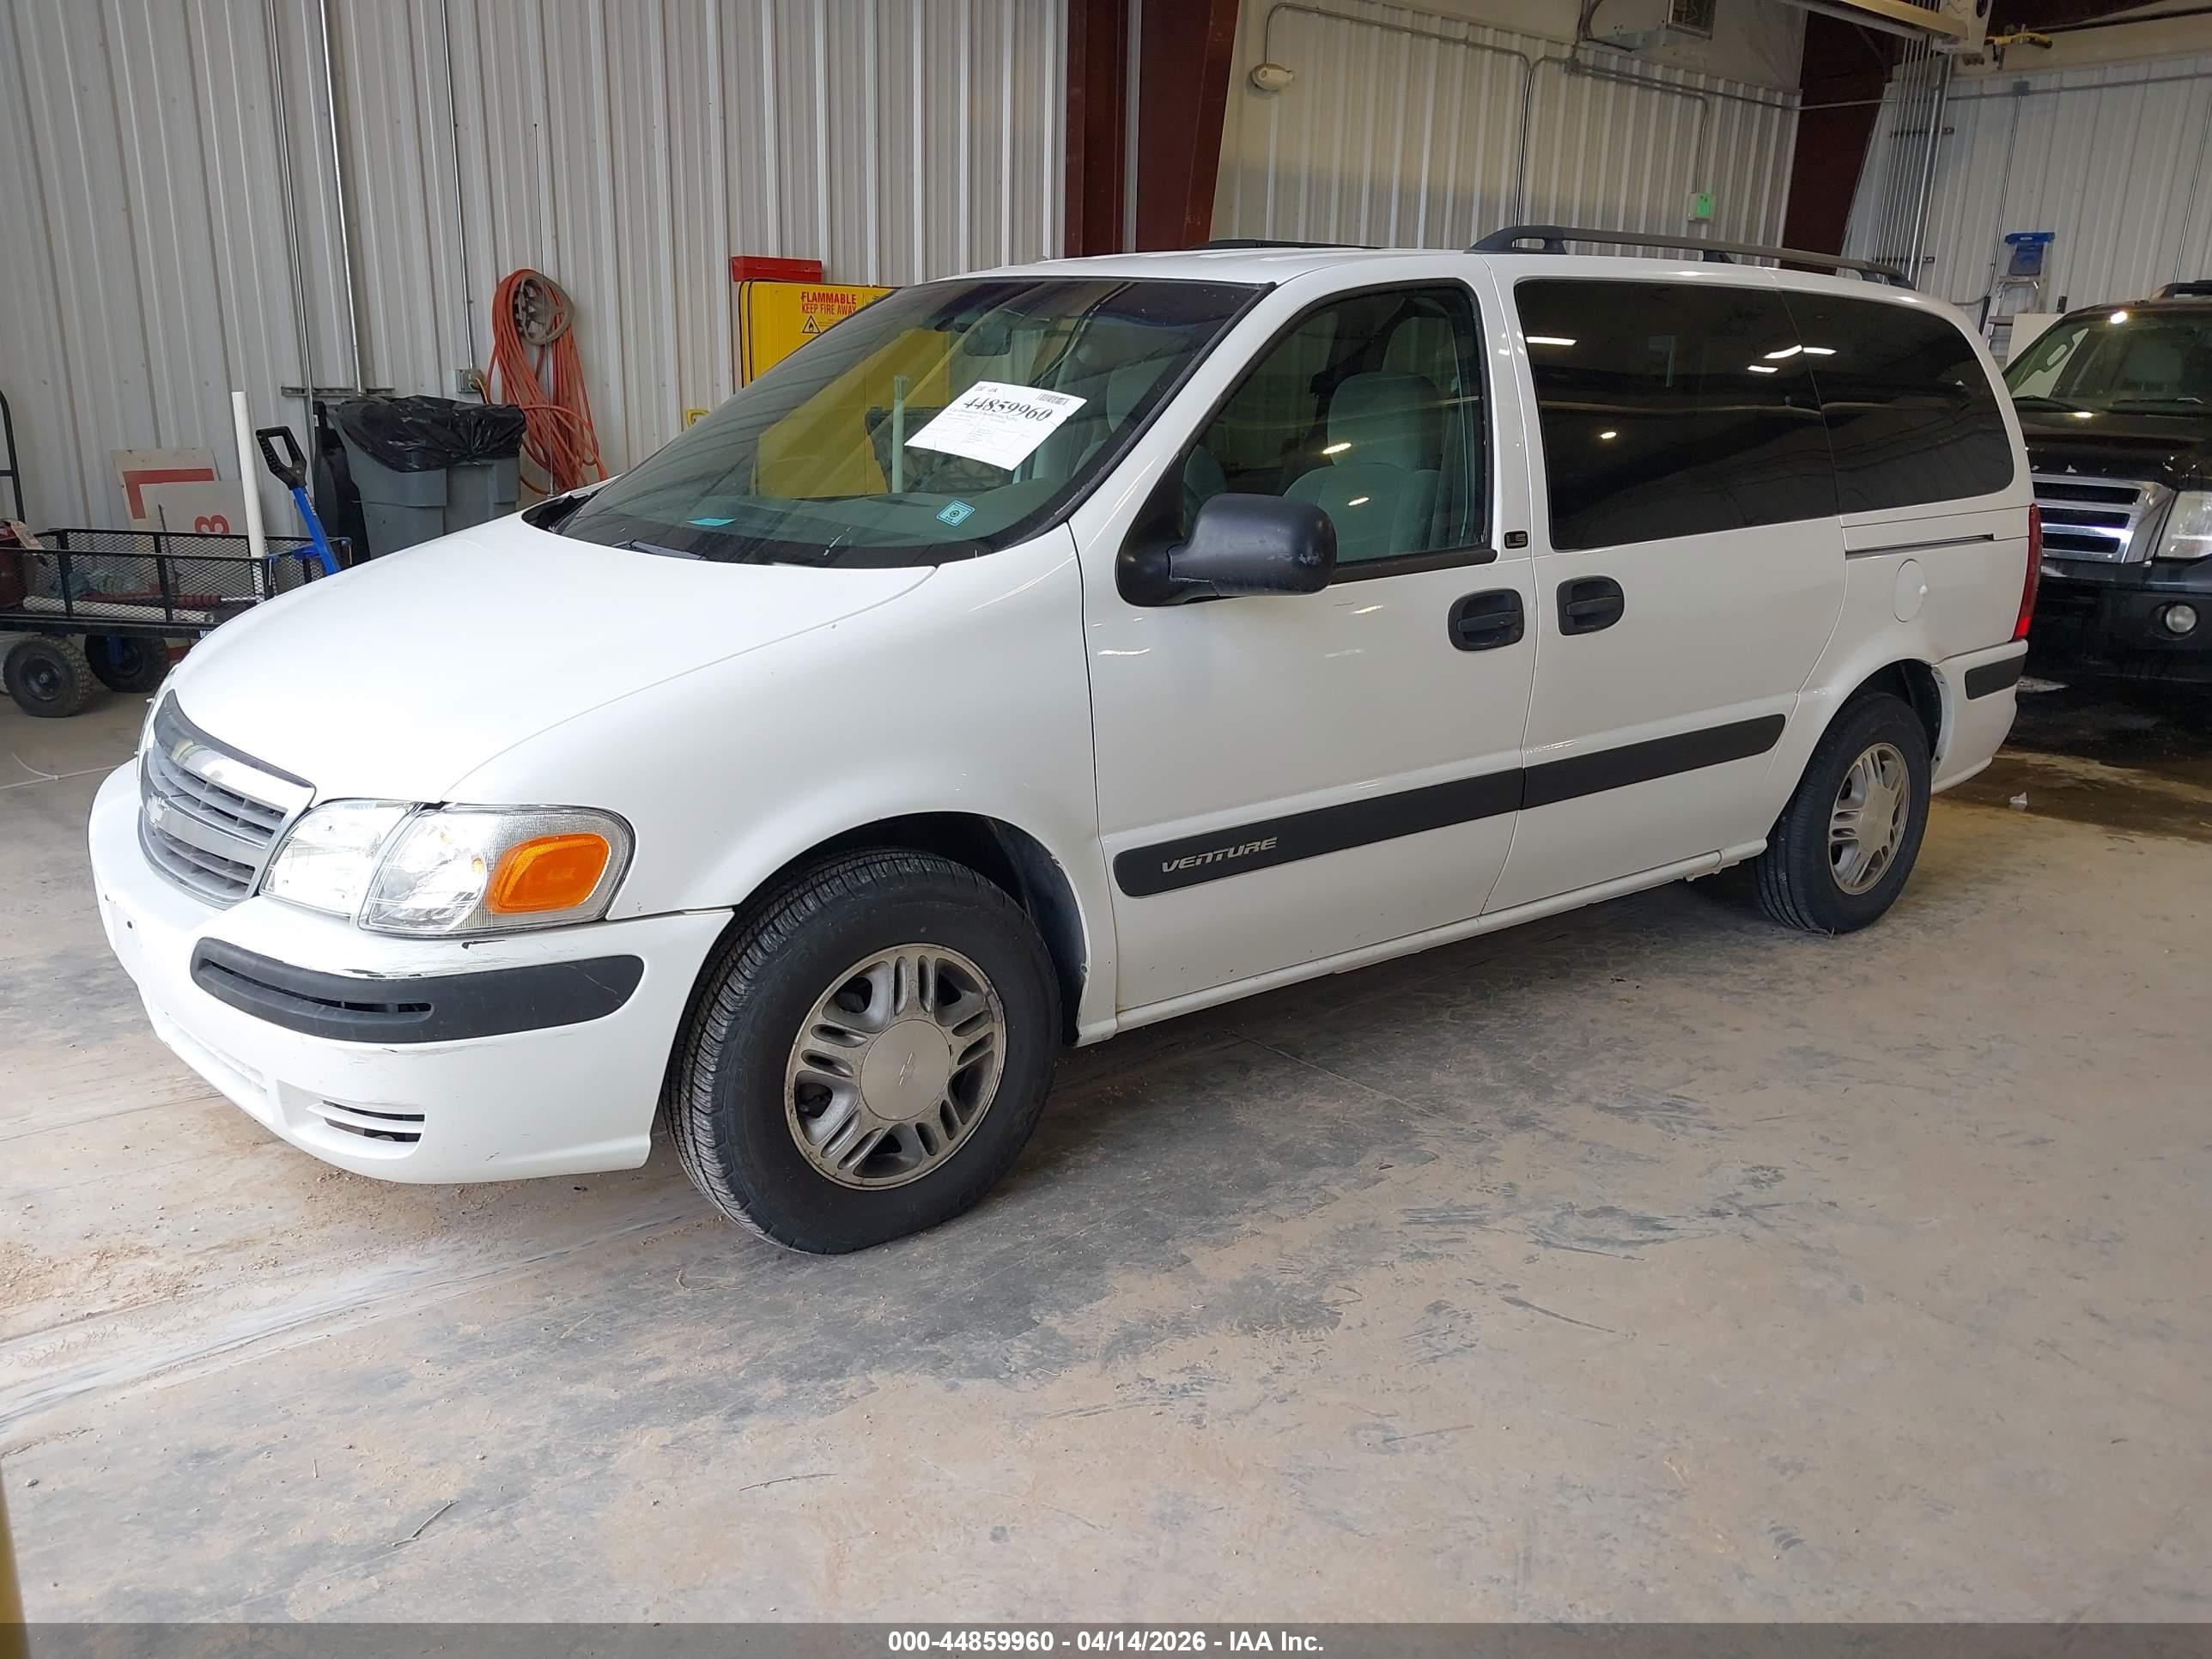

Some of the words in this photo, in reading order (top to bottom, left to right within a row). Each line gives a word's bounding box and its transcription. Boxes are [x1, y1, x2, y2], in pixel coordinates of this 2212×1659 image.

[801, 291, 857, 305] FLAMMABLE
[802, 303, 817, 314] KEEP
[820, 304, 836, 315] FIRE
[837, 305, 857, 316] AWAY
[963, 397, 1053, 422] 44859960
[1162, 836, 1278, 872] VENTURE
